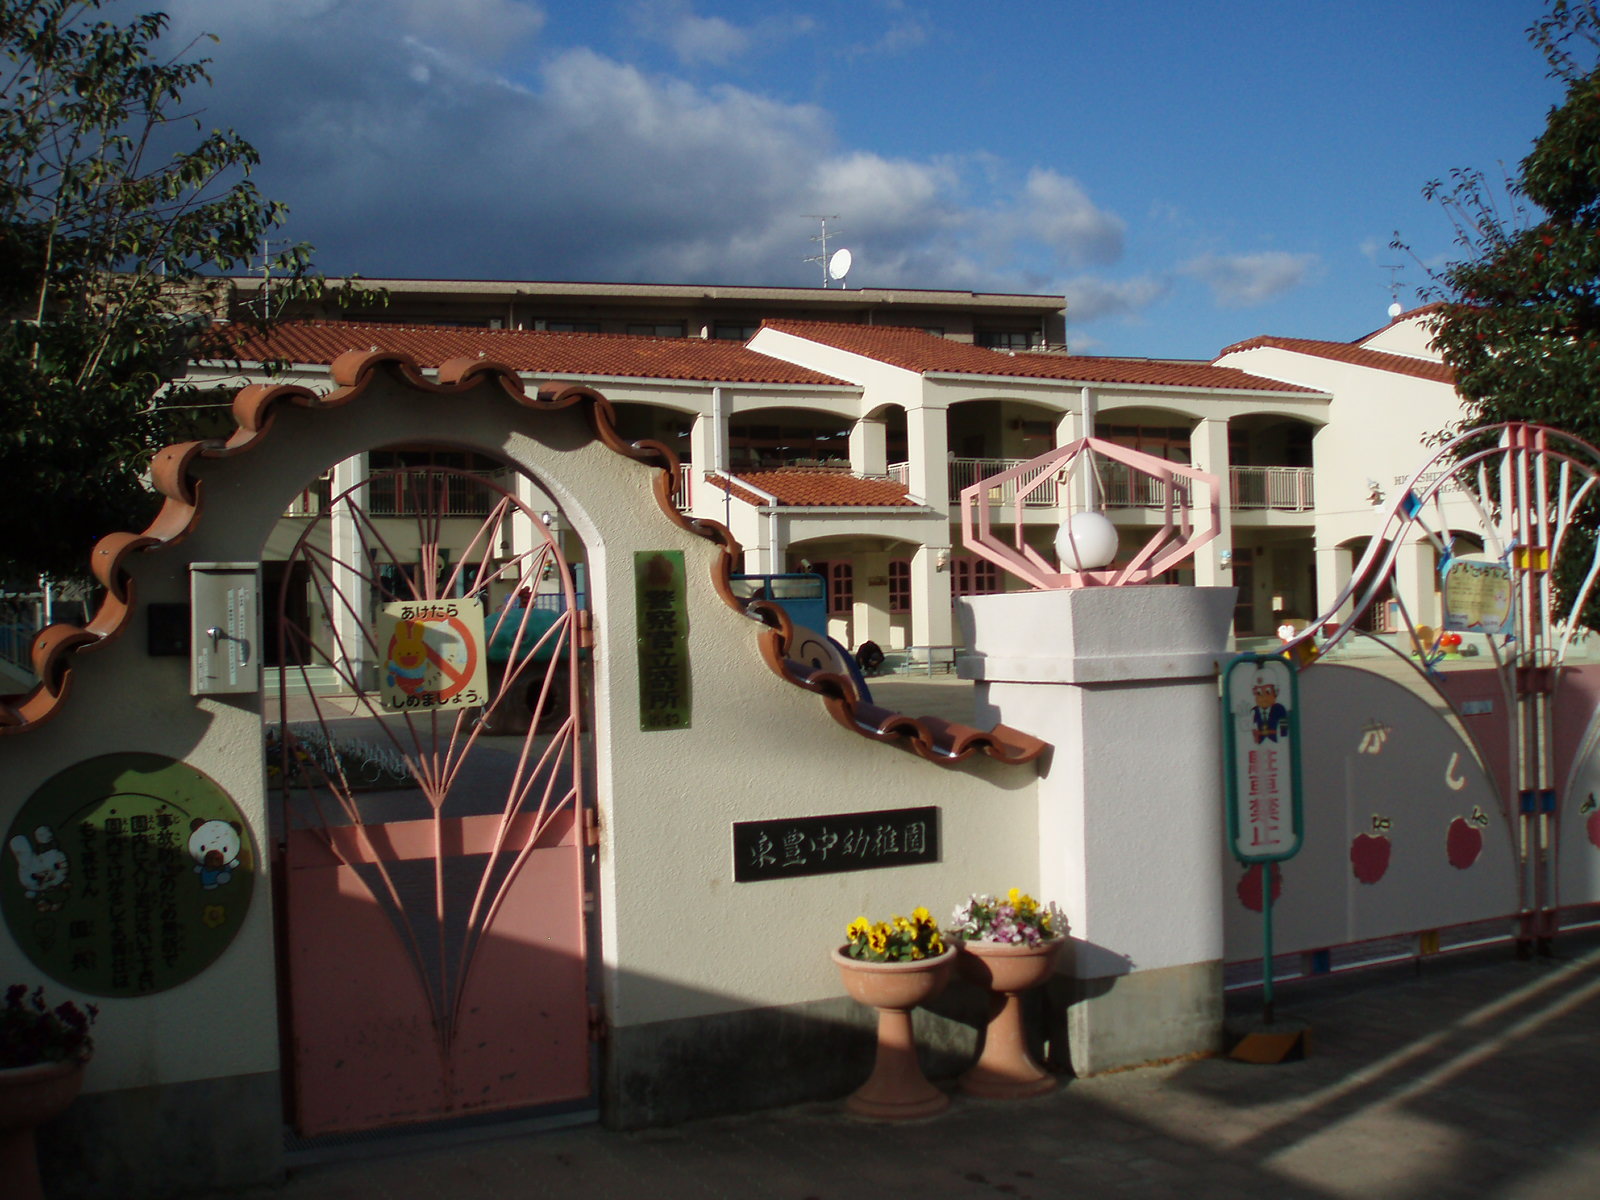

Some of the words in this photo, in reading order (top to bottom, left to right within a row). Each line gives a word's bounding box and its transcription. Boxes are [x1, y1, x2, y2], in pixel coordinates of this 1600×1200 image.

[401, 604, 459, 620] あけたら
[644, 589, 681, 710] 警察官立寄所
[392, 689, 479, 709] しめましょう
[1248, 749, 1280, 846] 駐車禁止
[79, 822, 99, 899] もてません
